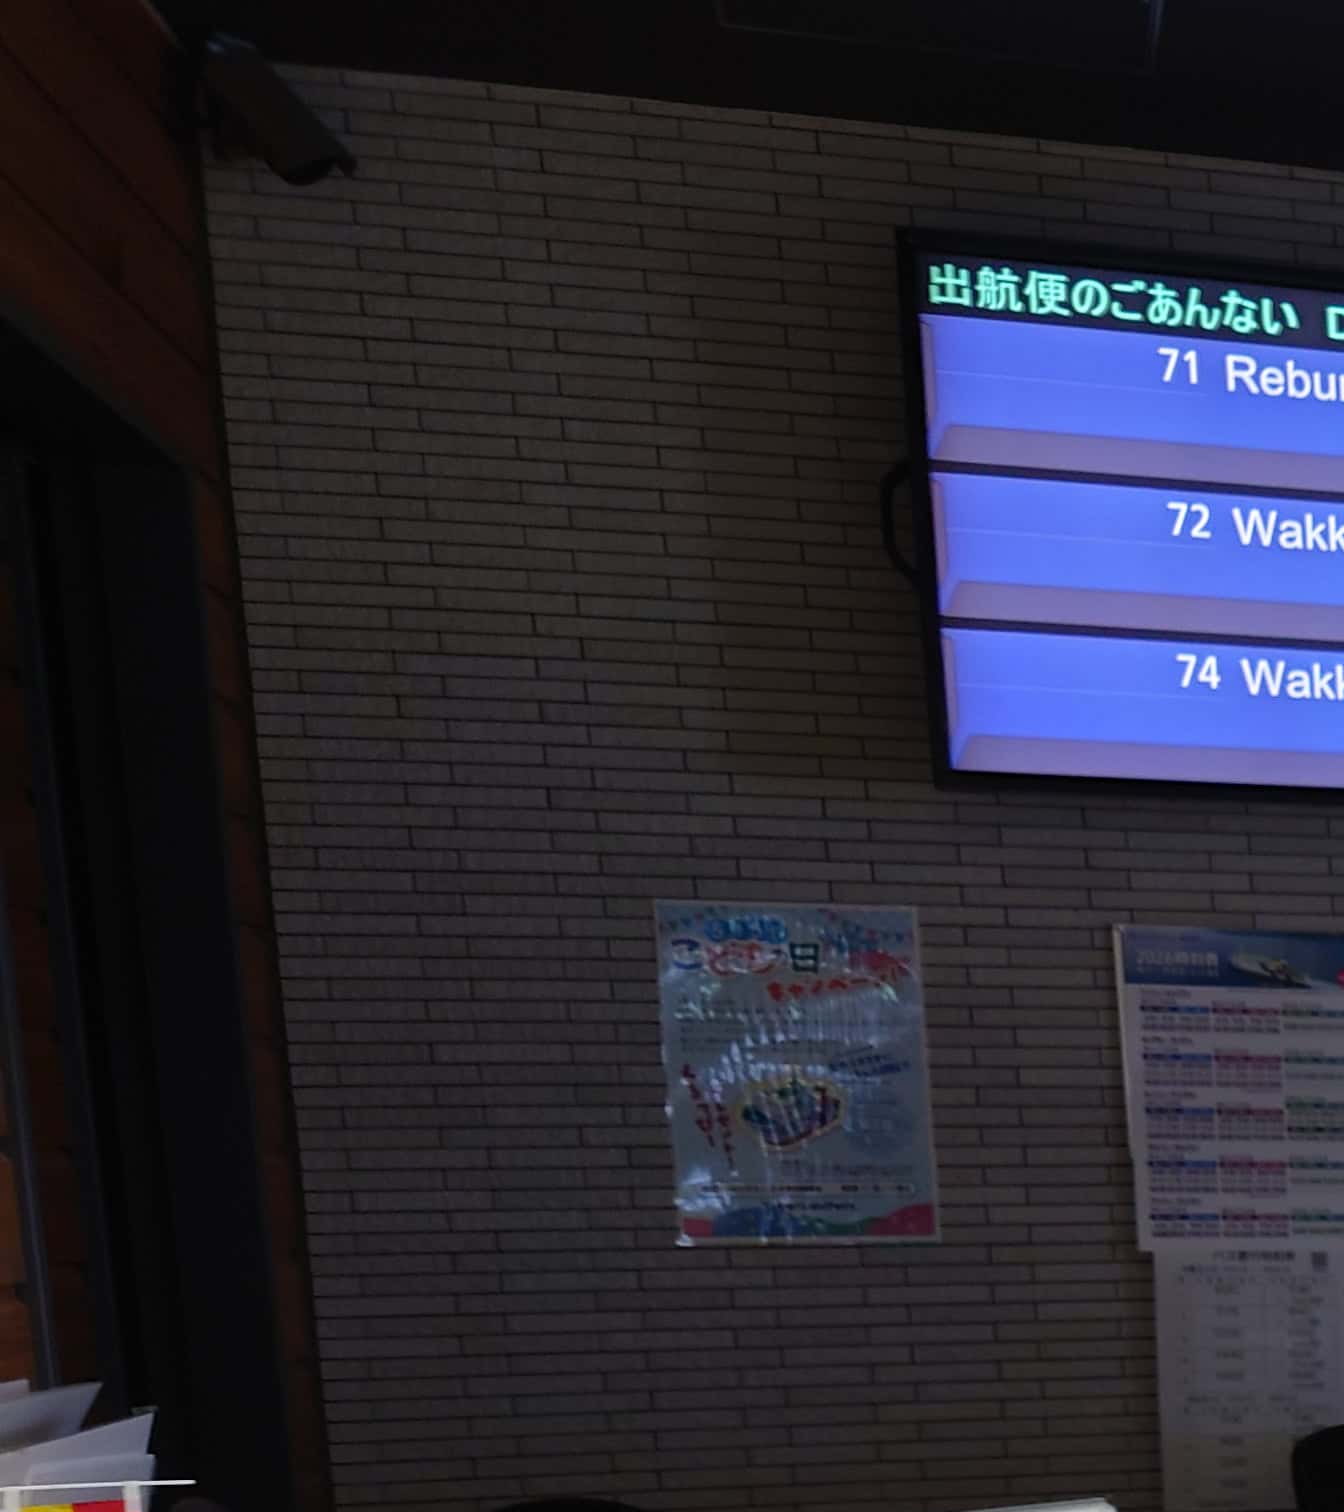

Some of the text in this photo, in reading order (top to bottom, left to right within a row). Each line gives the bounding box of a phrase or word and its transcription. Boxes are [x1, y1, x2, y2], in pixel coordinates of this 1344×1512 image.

[928, 264, 1299, 335] 出航便のごあんない
[1157, 348, 1201, 386] 71
[1166, 502, 1211, 539] 72
[1175, 655, 1222, 692] 74
